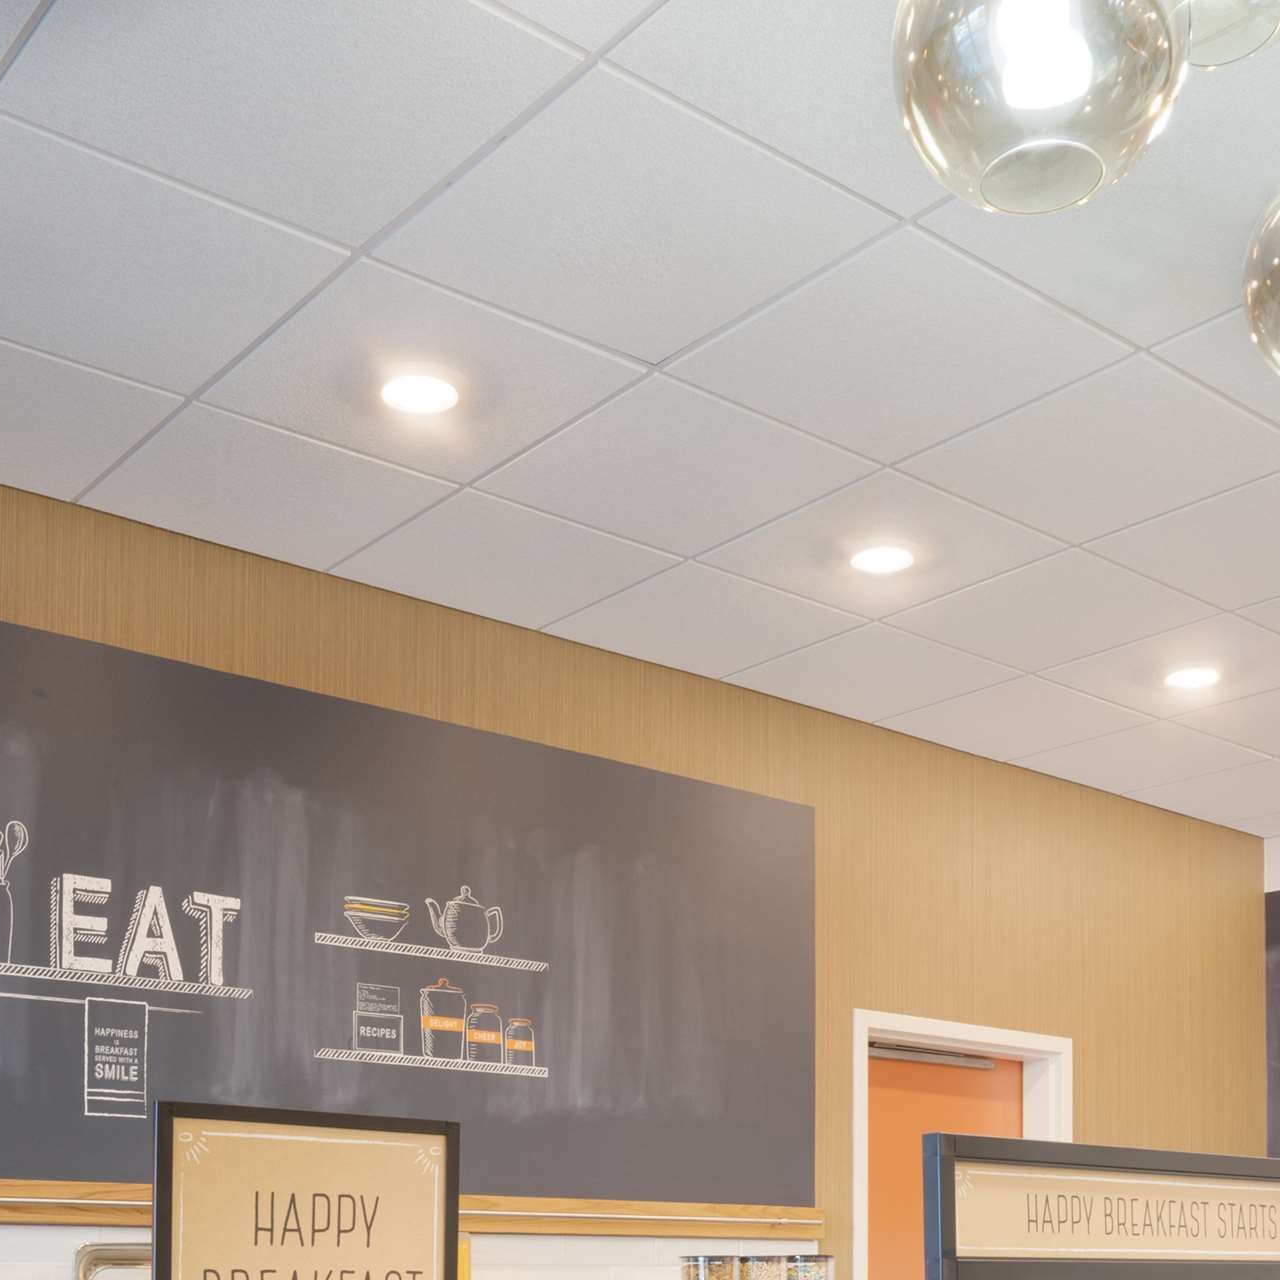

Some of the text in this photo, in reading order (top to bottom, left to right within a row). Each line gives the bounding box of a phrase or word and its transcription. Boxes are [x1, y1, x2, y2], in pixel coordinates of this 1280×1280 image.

[50, 873, 241, 986] EAT
[94, 1027, 139, 1039] HAPPINESS
[360, 1026, 397, 1039] RECIPES
[95, 1045, 138, 1056] BREAKFAST
[95, 1055, 117, 1063] SERVED
[95, 1063, 139, 1081] SMILE
[254, 1191, 380, 1248] HAPPY
[1026, 1193, 1094, 1235] HAPPY
[1104, 1197, 1209, 1238] BREAKFAST
[1217, 1202, 1277, 1240] STARTS
